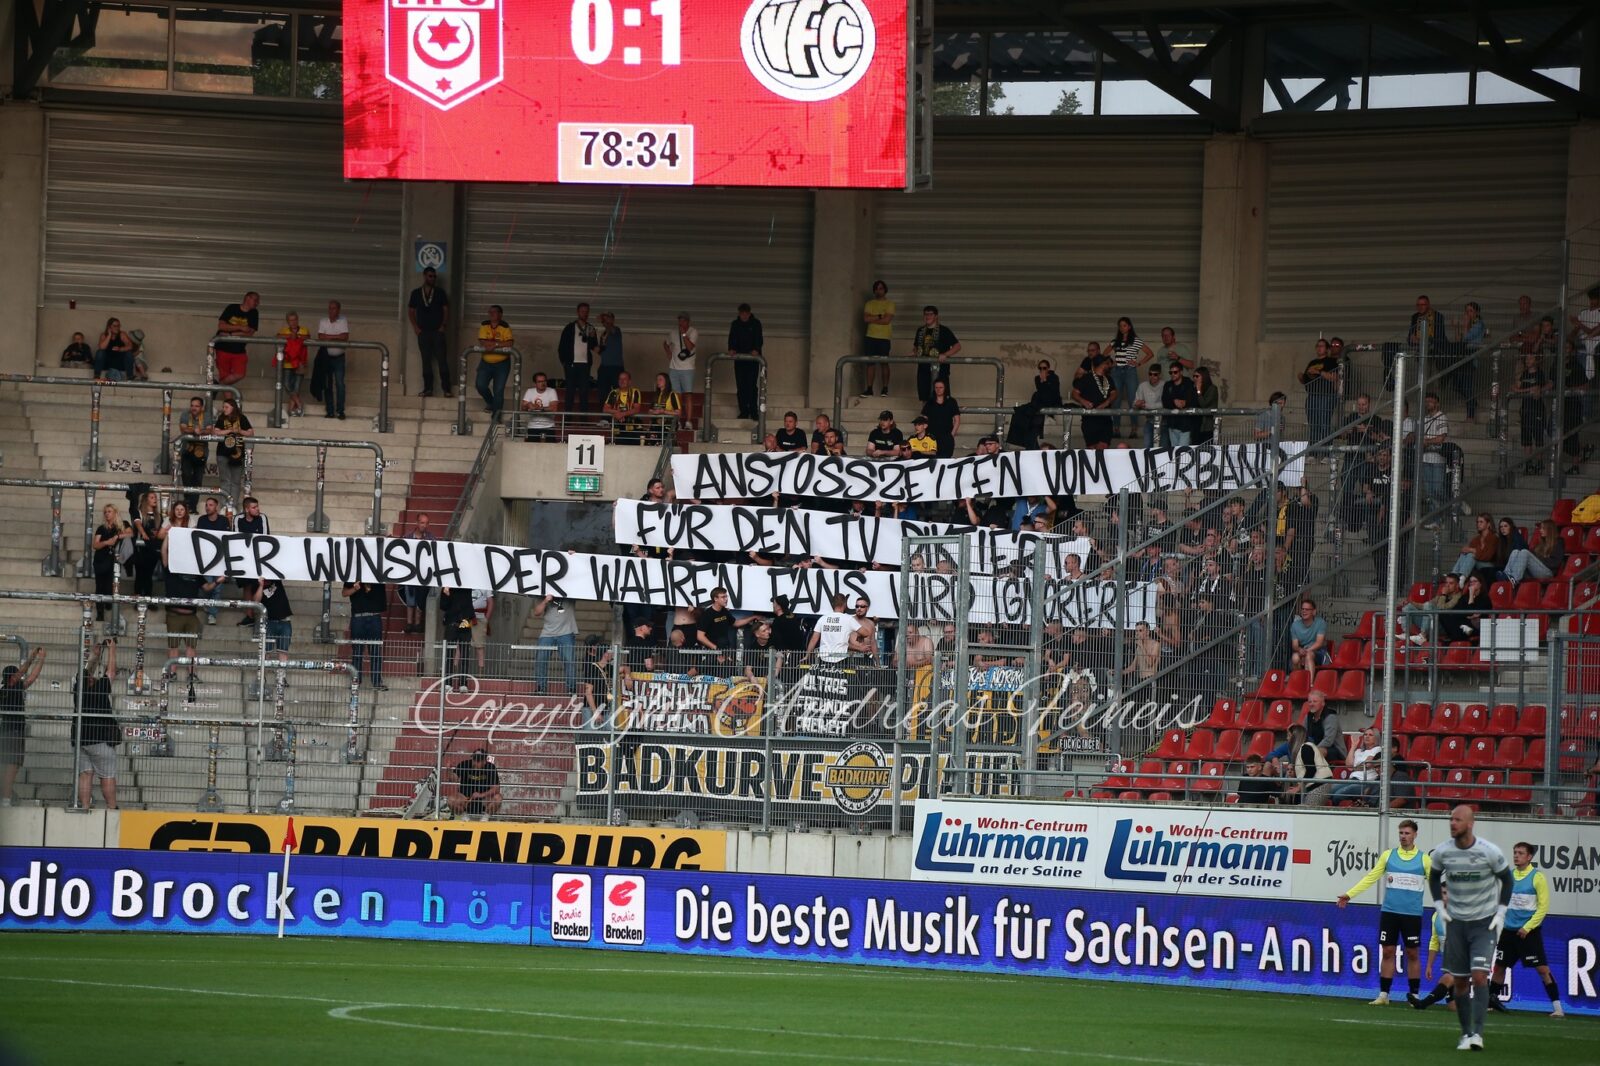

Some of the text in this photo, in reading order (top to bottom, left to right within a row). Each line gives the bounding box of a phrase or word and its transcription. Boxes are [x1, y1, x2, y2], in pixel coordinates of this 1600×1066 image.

[570, 0, 682, 66] 0:1
[758, 0, 864, 78] VFC
[579, 131, 680, 169] 78:34
[575, 443, 596, 466] 11
[693, 443, 1284, 500] ANSTOSSZEITEN VOM VERBAND
[637, 503, 1078, 579] FÜR DEN TV DIKTIERT
[191, 530, 285, 580] DER
[303, 537, 462, 587] WUNSCH
[484, 545, 568, 598] DER
[591, 556, 743, 609] WAHREN
[769, 567, 870, 614] FANS
[889, 572, 976, 622] WIRD
[576, 744, 826, 802] BADKURVE
[829, 768, 889, 785] BADKURVE
[976, 816, 1089, 833] Wohn-Centrum
[1169, 824, 1288, 841] Wohn-Centrum
[914, 811, 1089, 873] Lührmann
[1104, 818, 1289, 882] Lührmann
[980, 864, 1083, 879] an der Saline
[1173, 872, 1282, 889] an der Saline
[1552, 876, 1600, 893] WIRD'
[0, 861, 90, 917] dio
[111, 869, 384, 922] Brocken
[553, 921, 589, 937] Brocken
[559, 908, 582, 921] Radio
[611, 910, 636, 924] Radio
[605, 924, 643, 940] Brocken
[675, 885, 1404, 975] Die beste Musik für Sachsen-Anhat
